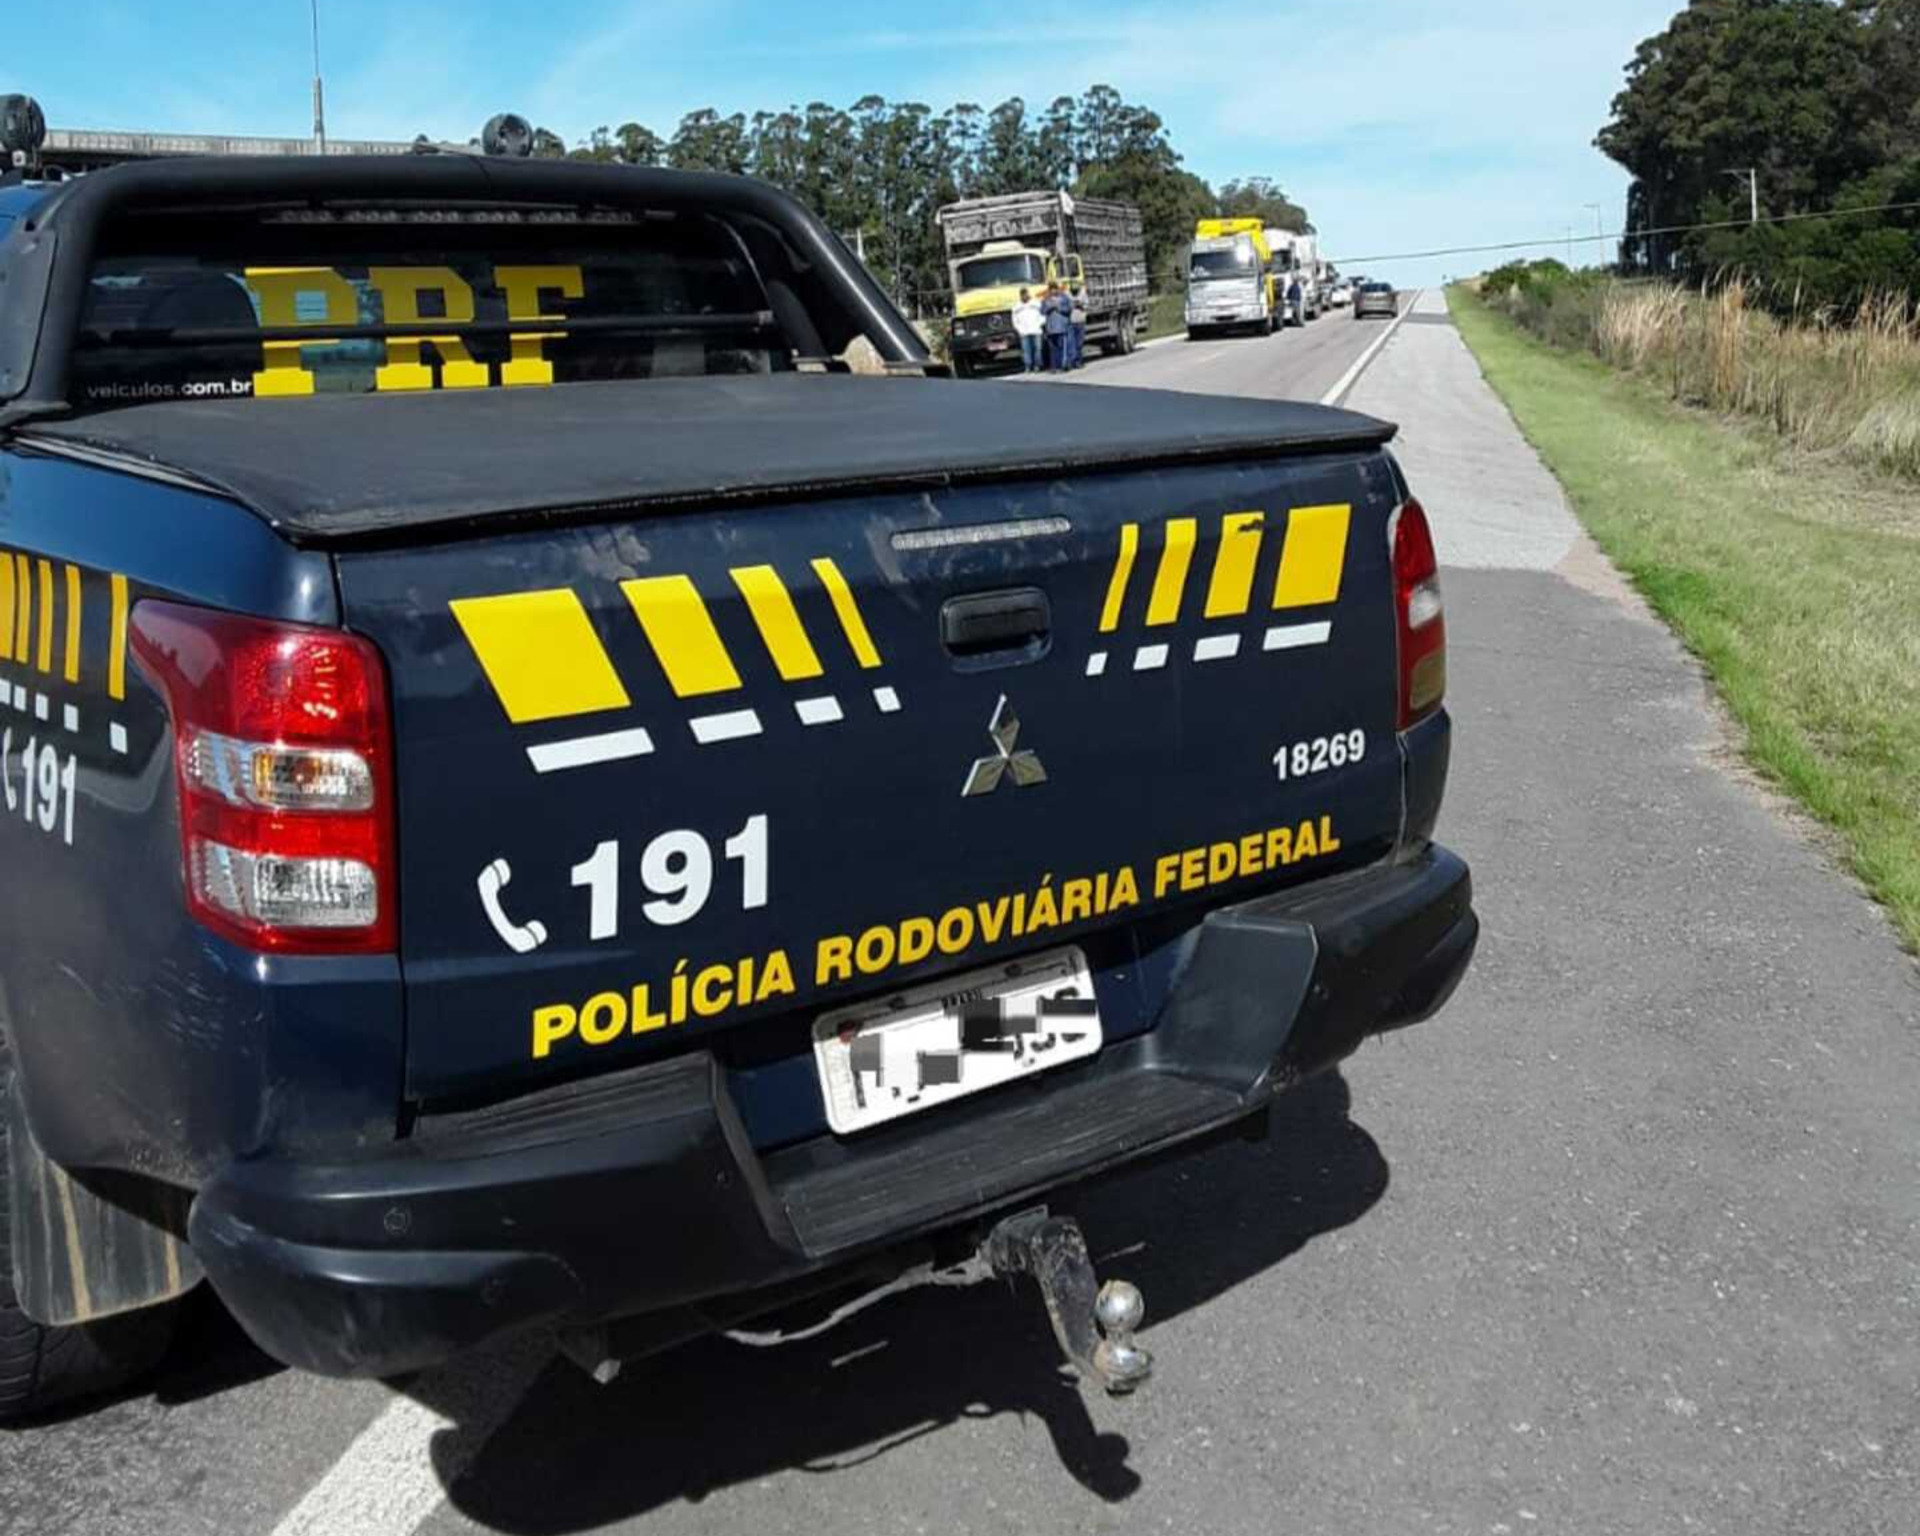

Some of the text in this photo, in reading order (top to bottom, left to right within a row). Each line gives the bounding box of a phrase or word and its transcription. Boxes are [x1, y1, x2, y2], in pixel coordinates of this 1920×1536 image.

[86, 378, 253, 398] veiculos.com.br
[245, 266, 583, 398] PRF
[21, 735, 77, 846] 191
[1272, 729, 1365, 780] 18269
[571, 814, 768, 940] 191
[532, 949, 796, 1059] POLÍCIA
[815, 866, 1139, 985] RODOVIÁRIA
[1154, 815, 1341, 899] FEDERAL
